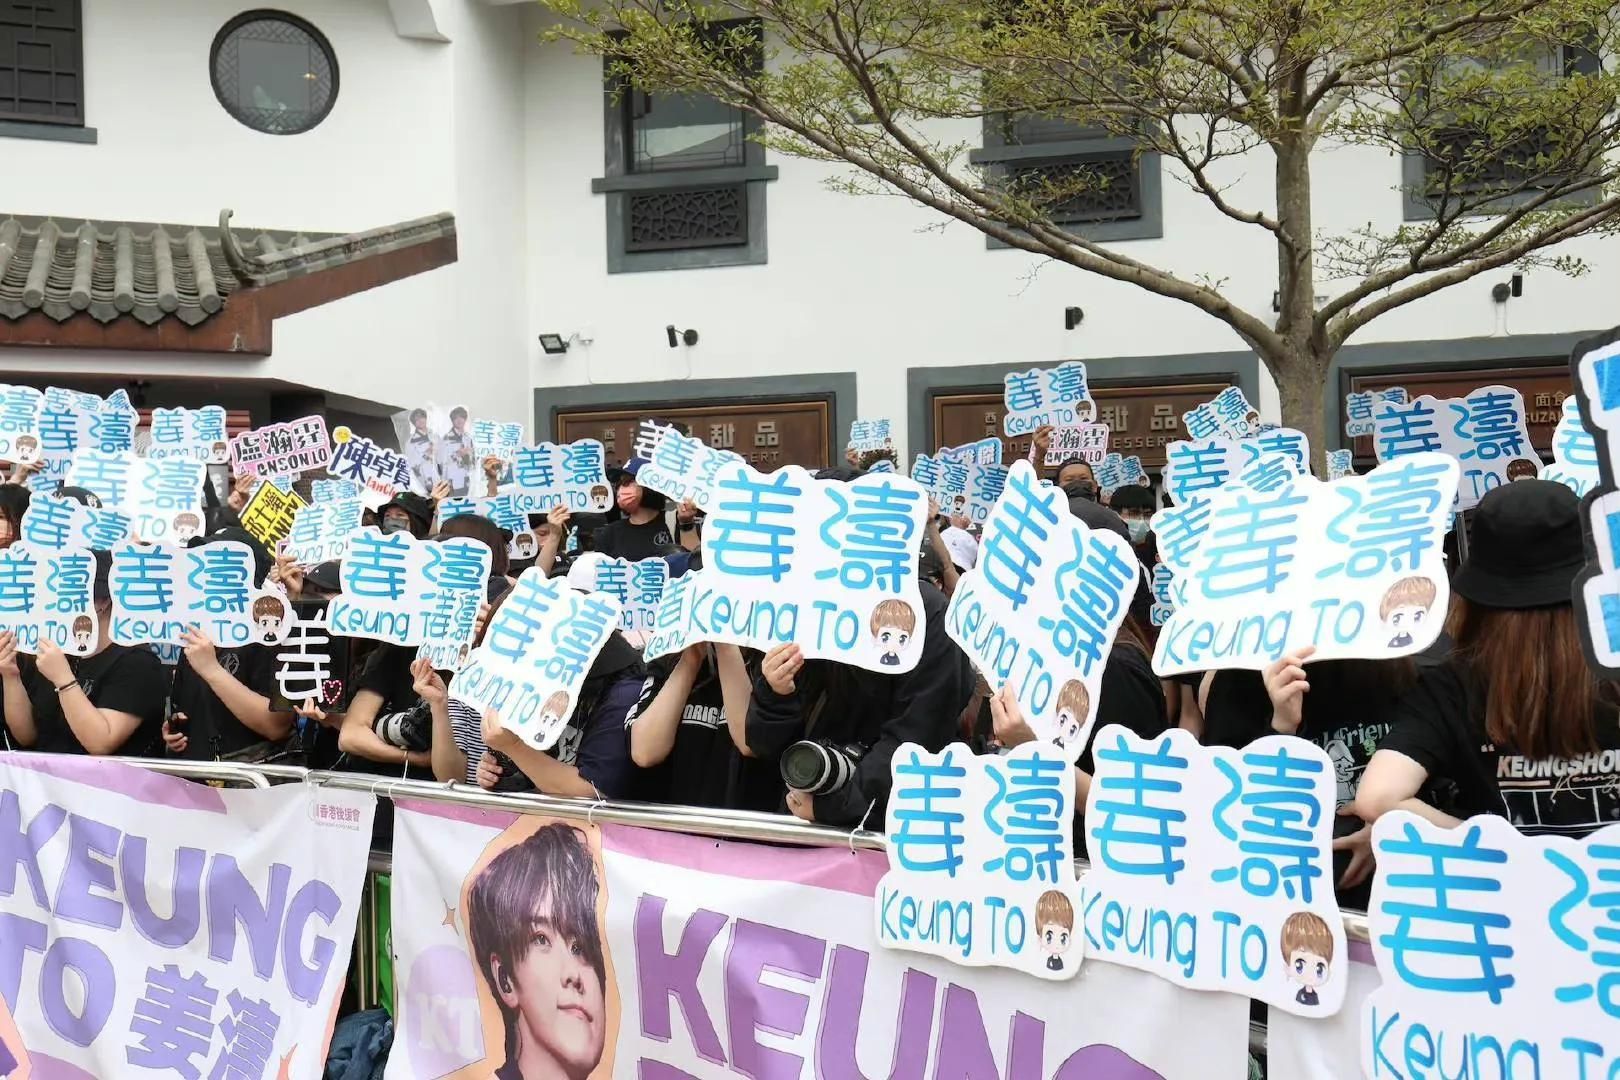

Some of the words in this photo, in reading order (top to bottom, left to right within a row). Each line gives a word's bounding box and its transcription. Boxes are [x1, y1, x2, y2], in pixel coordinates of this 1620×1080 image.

[0, 389, 41, 433] 濤
[1006, 364, 1086, 411] 姜濤
[1053, 408, 1073, 423] To
[1187, 387, 1249, 439] 姜濤
[38, 408, 132, 453] 姜濤
[153, 409, 223, 443] 姜濤
[473, 420, 522, 446] 姜濤
[853, 418, 890, 440] 姜濤
[1050, 428, 1104, 449] 瀚霆
[1348, 423, 1376, 435] Keun
[1375, 391, 1524, 461] 姜濤
[73, 449, 201, 511] 姜濤
[516, 443, 603, 488] 姜濤
[914, 456, 969, 494] 姜濤
[24, 495, 131, 551] 姜濤
[292, 500, 362, 544] 姜濤
[513, 492, 562, 514] Keung
[566, 490, 587, 508] To
[707, 468, 920, 593] 姜濤
[1195, 462, 1451, 600] 姜濤
[0, 551, 91, 613] 姜濤
[113, 545, 250, 613] 姜濤
[345, 531, 487, 601] 姜濤
[596, 559, 665, 604] 姜濤
[984, 471, 1134, 677] 姜濤
[114, 617, 201, 641] Keun
[212, 619, 250, 642] To
[331, 603, 410, 641] Keung
[430, 588, 480, 641] 姜濤
[489, 572, 617, 687] 姜濤
[688, 587, 798, 644] Keung
[812, 600, 859, 651] To
[1160, 609, 1293, 662] Keung
[1308, 598, 1366, 646] To
[949, 582, 1020, 688] Keung
[1018, 648, 1053, 716] To
[510, 682, 541, 724] To
[890, 751, 1066, 883] 姜濤
[1091, 734, 1323, 904] 姜濤
[0, 788, 342, 1008] KEUNG
[880, 886, 972, 957] Keung
[984, 896, 1026, 955] To
[1081, 890, 1197, 978] Keung
[1212, 910, 1268, 981] To
[0, 911, 117, 1048] TO
[632, 892, 1168, 1080] KEUN
[125, 963, 281, 1080] 姜濤
[1371, 1005, 1541, 1080] Keung
